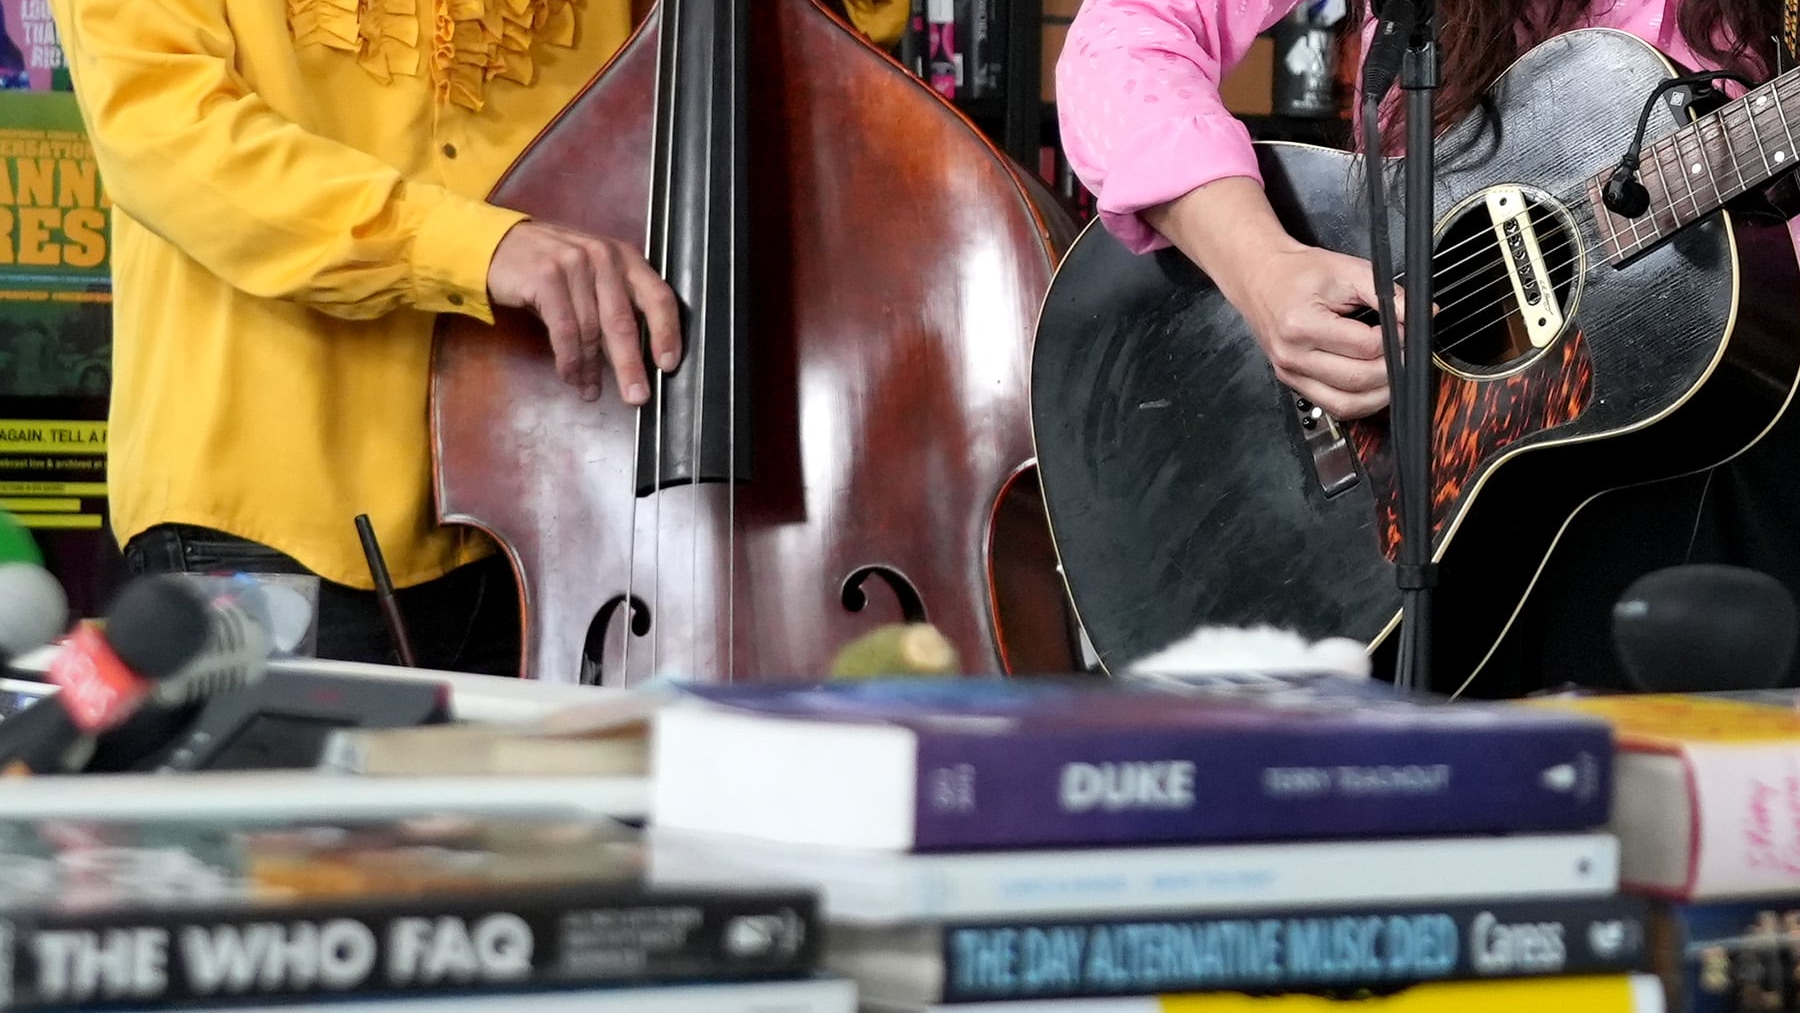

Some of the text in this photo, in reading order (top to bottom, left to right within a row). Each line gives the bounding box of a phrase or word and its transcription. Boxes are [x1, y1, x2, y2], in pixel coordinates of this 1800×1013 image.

[51, 429, 84, 443] TELL
[1060, 761, 1197, 813] DUKE
[34, 927, 168, 989] THE
[180, 919, 377, 988] WHO
[388, 912, 535, 979] FAQ
[952, 911, 1567, 988] THE DAY ALTERNATIVE MUSIC DIED Caress
